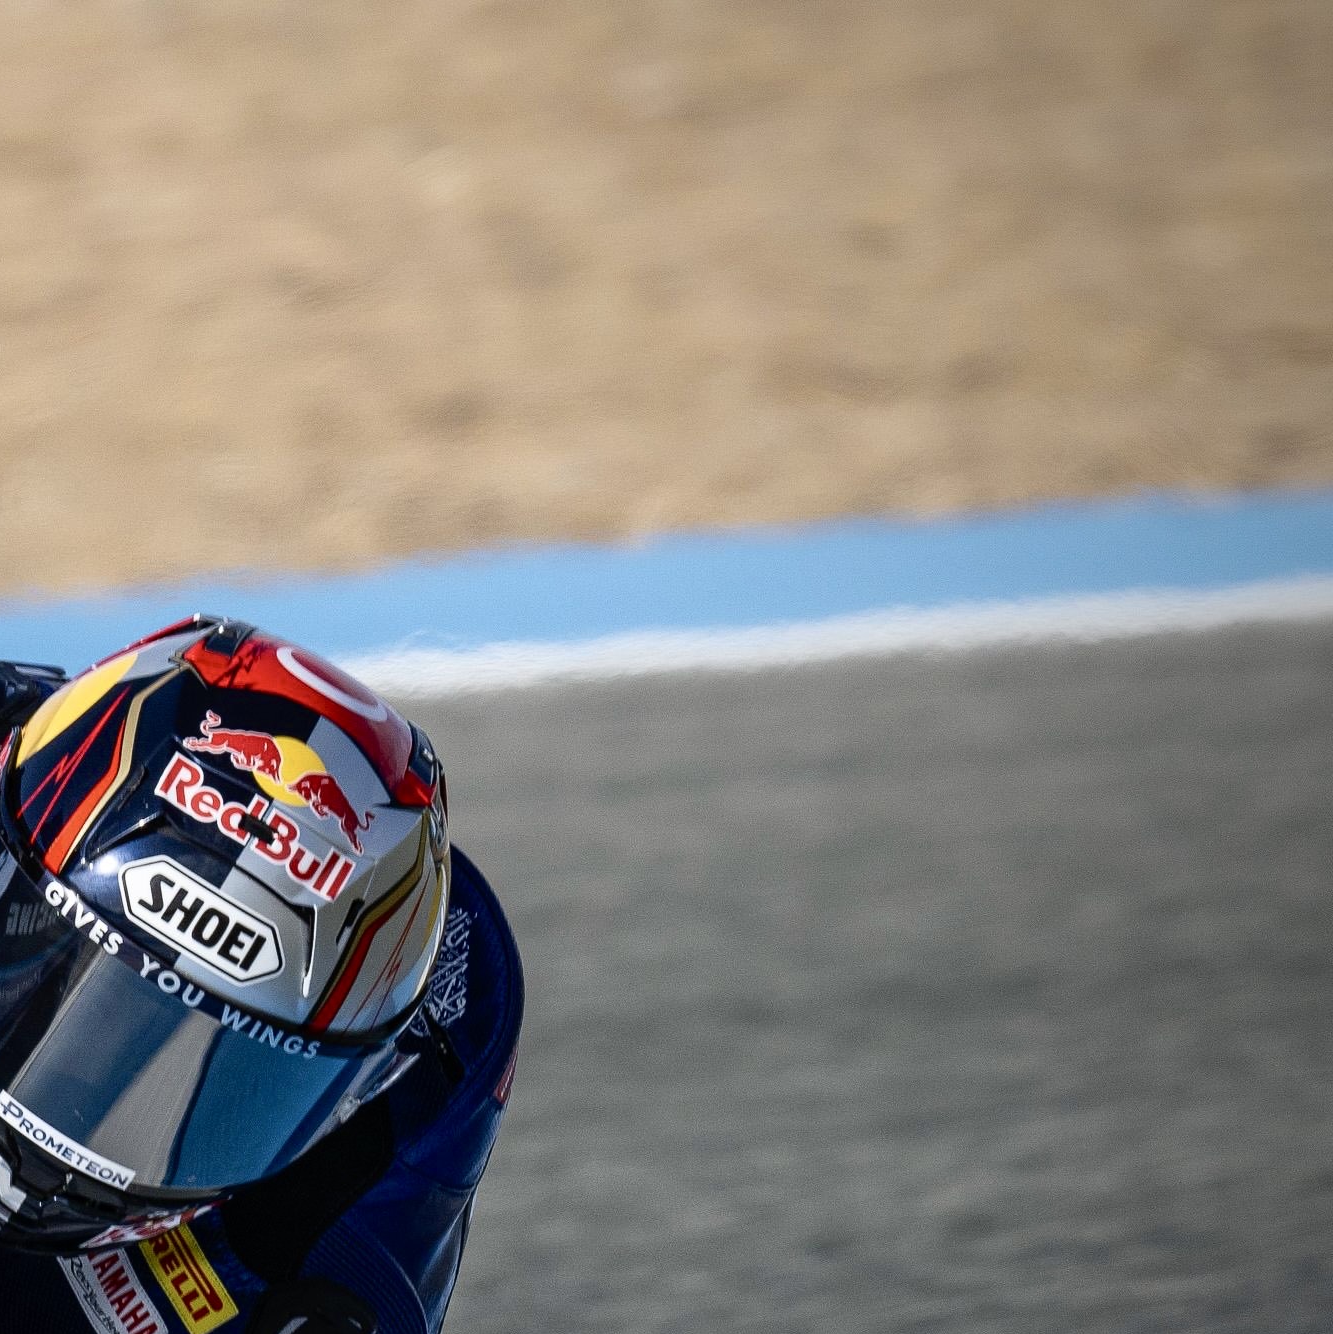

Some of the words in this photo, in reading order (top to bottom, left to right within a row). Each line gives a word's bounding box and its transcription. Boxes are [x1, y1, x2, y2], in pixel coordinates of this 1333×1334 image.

[44, 881, 123, 955] GIVES
[139, 955, 205, 1007] YOU
[221, 1004, 319, 1059] WINGS
[138, 873, 267, 972] SHOEI
[0, 1101, 128, 1189] PROMETEON
[148, 1227, 223, 1323] RELLI
